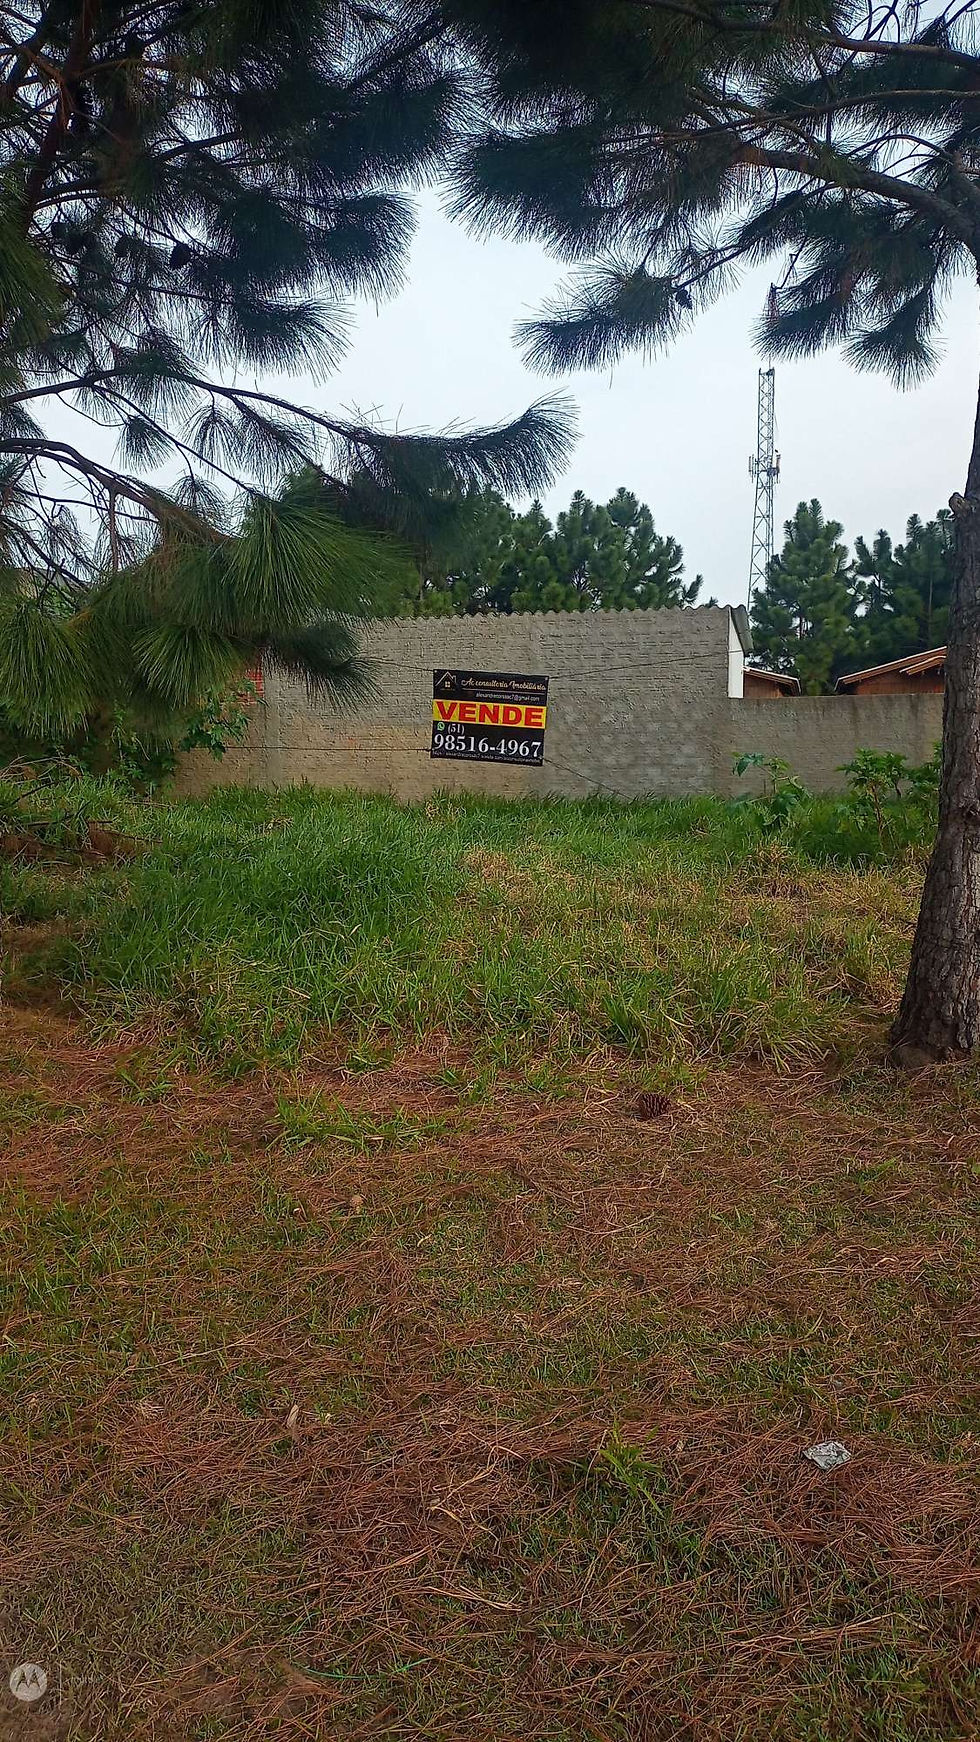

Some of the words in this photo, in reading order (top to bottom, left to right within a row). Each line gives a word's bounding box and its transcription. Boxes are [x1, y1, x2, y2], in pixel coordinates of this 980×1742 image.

[436, 701, 544, 727] VENDE
[447, 723, 465, 734] (51)
[434, 734, 542, 757] 98516-4967
